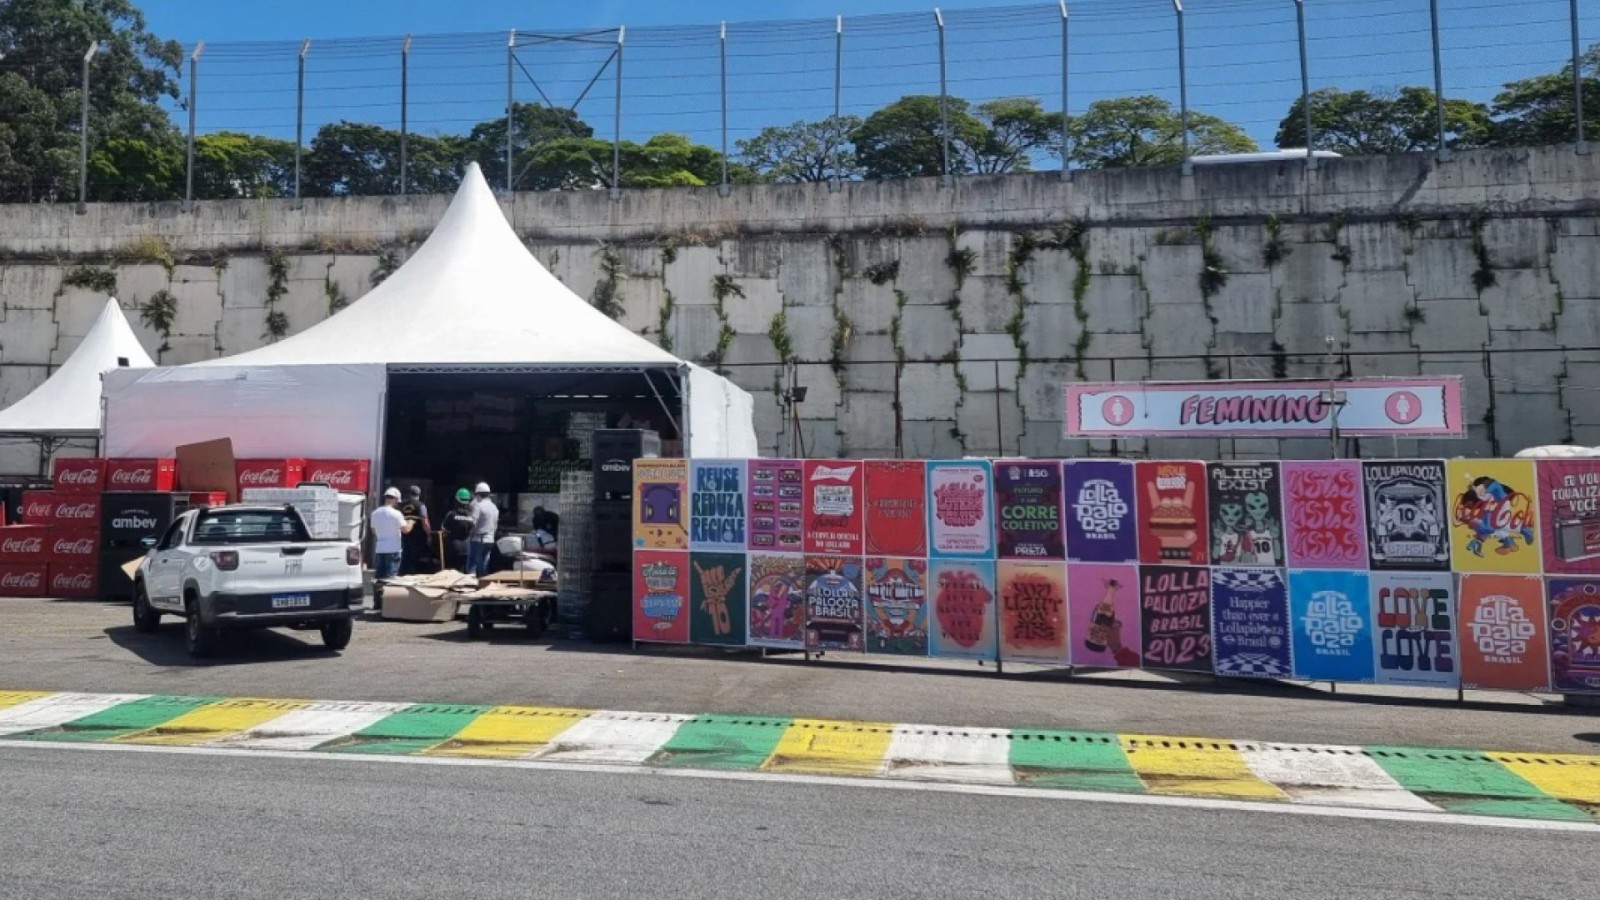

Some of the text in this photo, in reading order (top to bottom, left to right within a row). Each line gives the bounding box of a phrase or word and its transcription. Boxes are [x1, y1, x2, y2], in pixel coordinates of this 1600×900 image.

[1180, 394, 1330, 425] FEMININO
[601, 463, 631, 472] ambev
[1213, 468, 1273, 480] ALIENS
[1365, 465, 1443, 481] LOLLAPALOOZA
[697, 468, 739, 492] REUSE
[1218, 480, 1268, 491] EXIST
[692, 493, 744, 517] REDUZA
[1002, 506, 1058, 519] CORRE
[112, 516, 157, 529] ambev
[1002, 520, 1058, 531] COLETIVO
[691, 517, 744, 543] RECICLE
[1015, 546, 1048, 556] PRETA
[1254, 541, 1270, 553] 10
[1145, 570, 1208, 593] LOLLA
[810, 596, 858, 608] PALOOZA
[1144, 591, 1207, 614] PALOOZA
[1229, 597, 1270, 611] Happier
[1378, 587, 1450, 630] LOVE
[815, 607, 852, 617] BRASIL
[1222, 609, 1246, 621] than
[1248, 612, 1269, 621] ever
[1151, 615, 1204, 632] BRASIL
[1237, 636, 1267, 647] Brasil
[1145, 634, 1211, 664] 2023
[1380, 629, 1454, 673] LOVE
